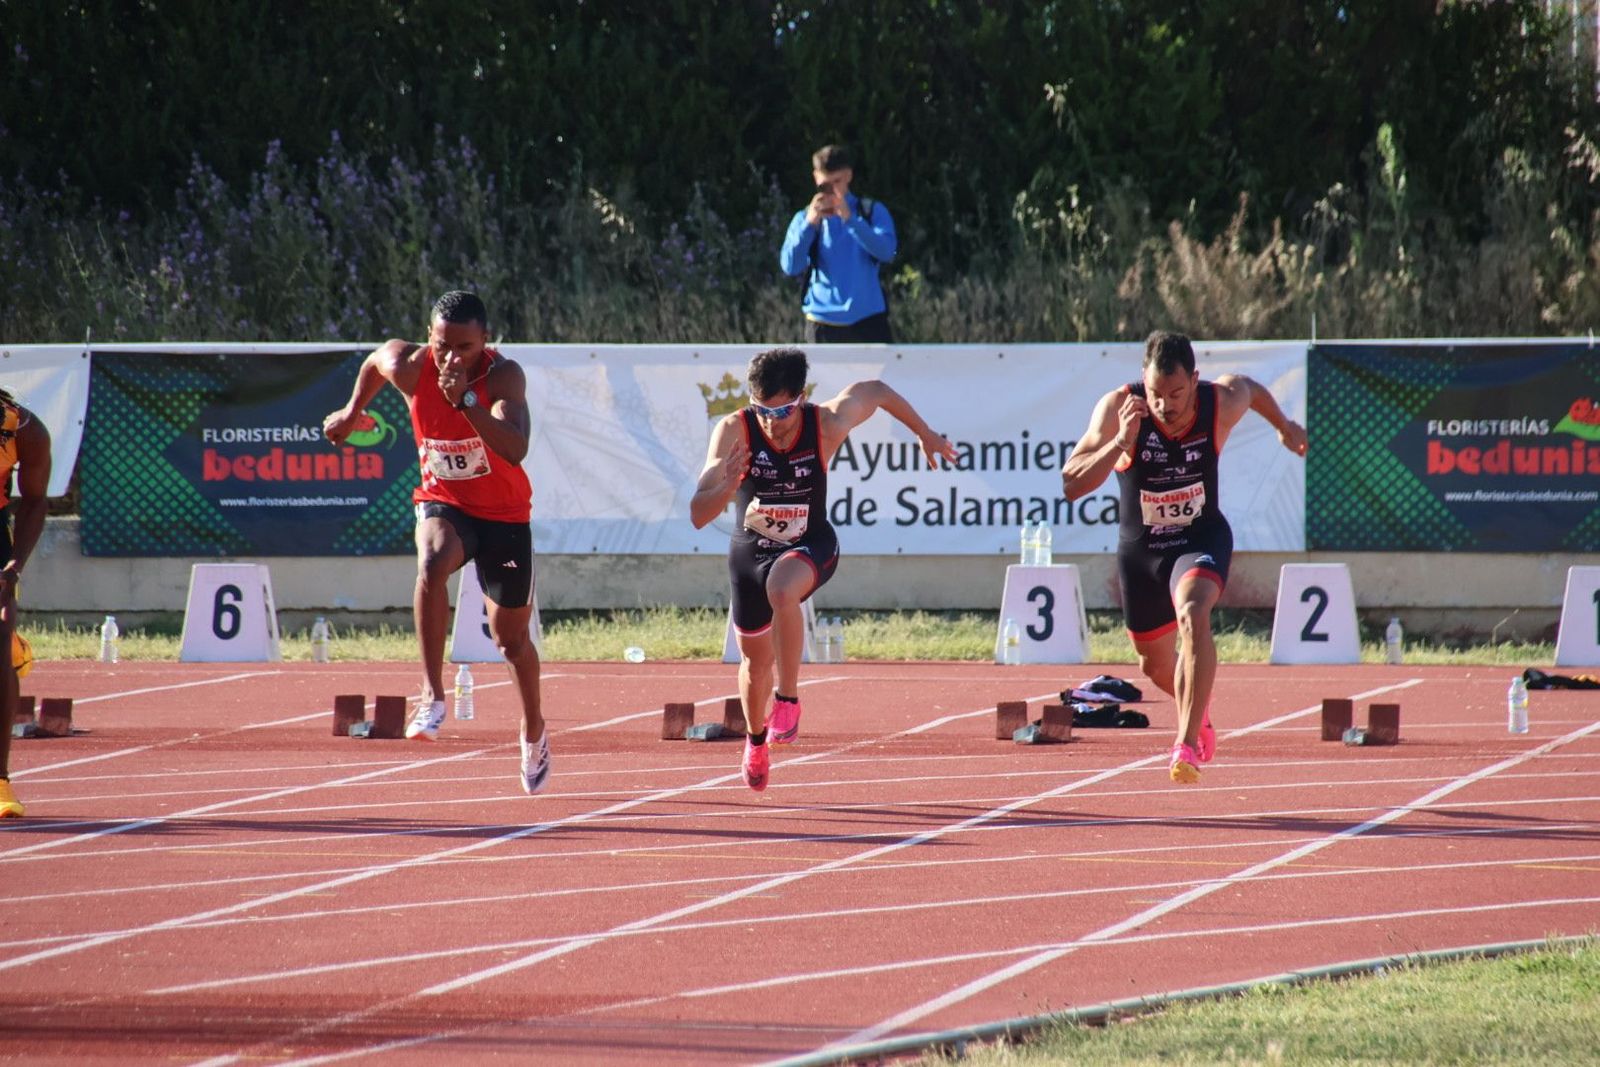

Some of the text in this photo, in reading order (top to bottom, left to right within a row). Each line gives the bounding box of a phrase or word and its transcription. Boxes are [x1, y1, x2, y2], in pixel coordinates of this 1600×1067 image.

[202, 424, 320, 443] FLORISTERÍAS
[1427, 416, 1549, 436] FLORISTERÍAS
[203, 447, 384, 481] bedunia
[444, 455, 467, 470] 18
[1142, 485, 1204, 504] bedunia
[830, 486, 1120, 527] de Salamanca
[1156, 502, 1194, 518] 136
[764, 516, 788, 533] 99
[212, 584, 243, 640] 6
[1026, 585, 1055, 642] 3
[1300, 586, 1329, 642] 2
